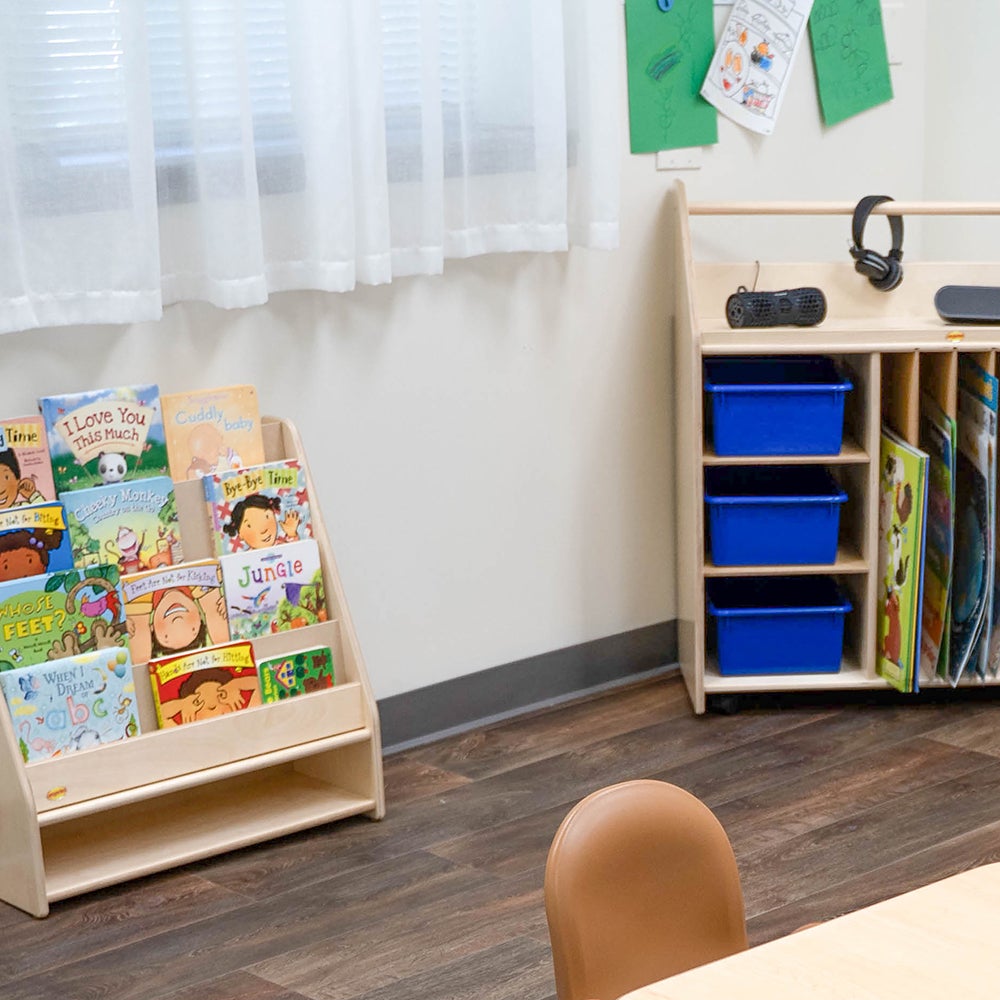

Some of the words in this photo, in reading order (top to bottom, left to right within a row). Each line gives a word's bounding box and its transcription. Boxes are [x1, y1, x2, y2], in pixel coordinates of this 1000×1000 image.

[63, 421, 73, 436] I
[73, 411, 113, 432] Love
[118, 407, 146, 426] You
[175, 407, 224, 425] Cuddly
[223, 416, 254, 433] baby
[5, 427, 38, 443] Time
[72, 431, 102, 450] This
[105, 428, 139, 442] Much
[223, 474, 265, 498] Bye-Bye
[268, 470, 294, 486] Time
[74, 493, 118, 522] Cheeky
[121, 488, 168, 507] Monkey
[238, 559, 303, 589] Jungle
[3, 608, 66, 642] FEET?
[43, 667, 76, 684] WHEN
[80, 666, 84, 677] I
[57, 680, 95, 697] DREAM
